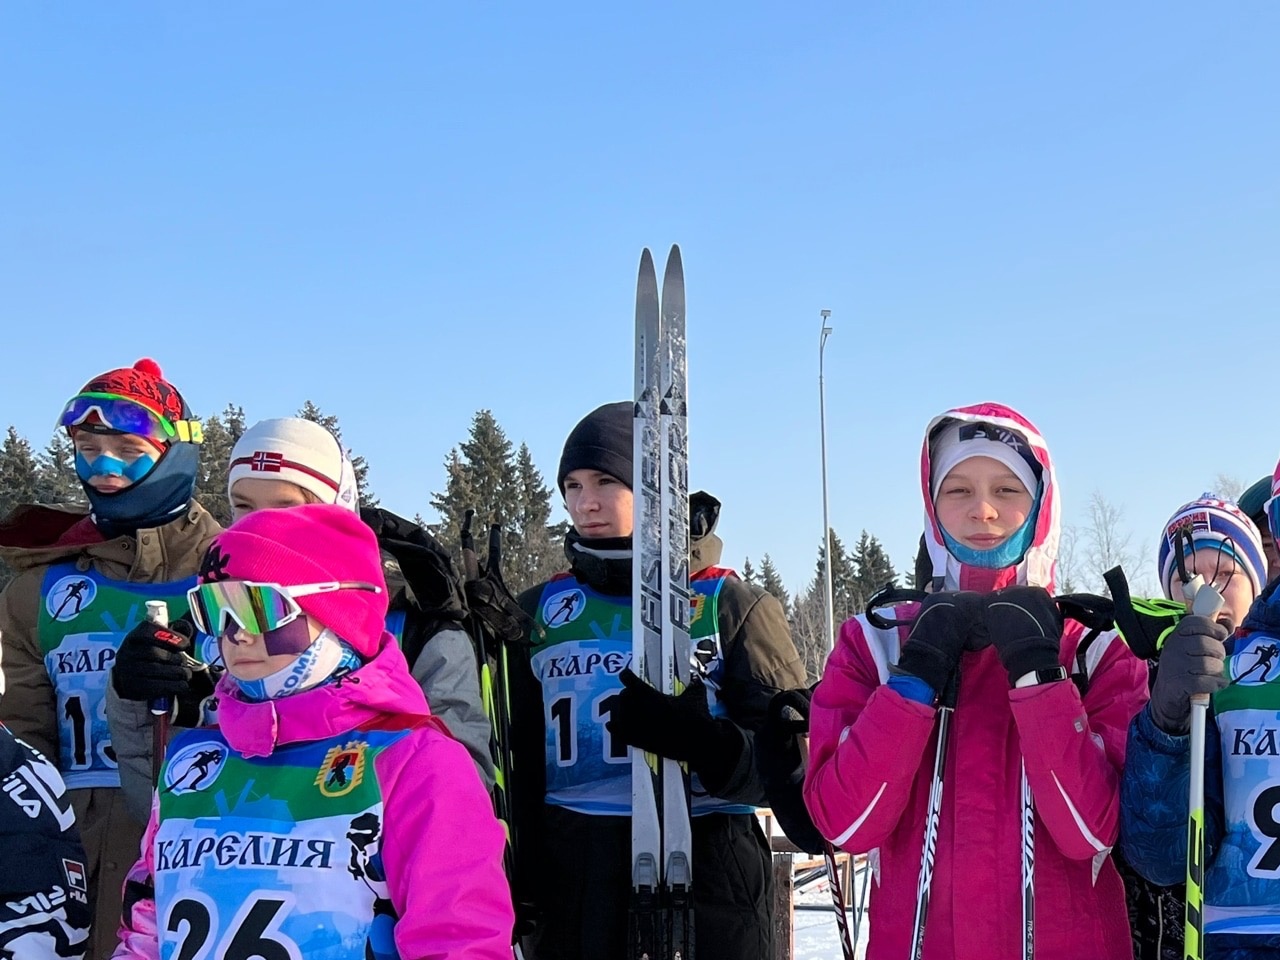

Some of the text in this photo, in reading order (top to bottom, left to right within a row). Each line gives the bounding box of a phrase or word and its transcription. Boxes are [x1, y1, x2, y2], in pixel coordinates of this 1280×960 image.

[640, 424, 662, 637] FISHER
[156, 834, 336, 872] КАРЕЛИЯ
[918, 778, 943, 898] SWIX
